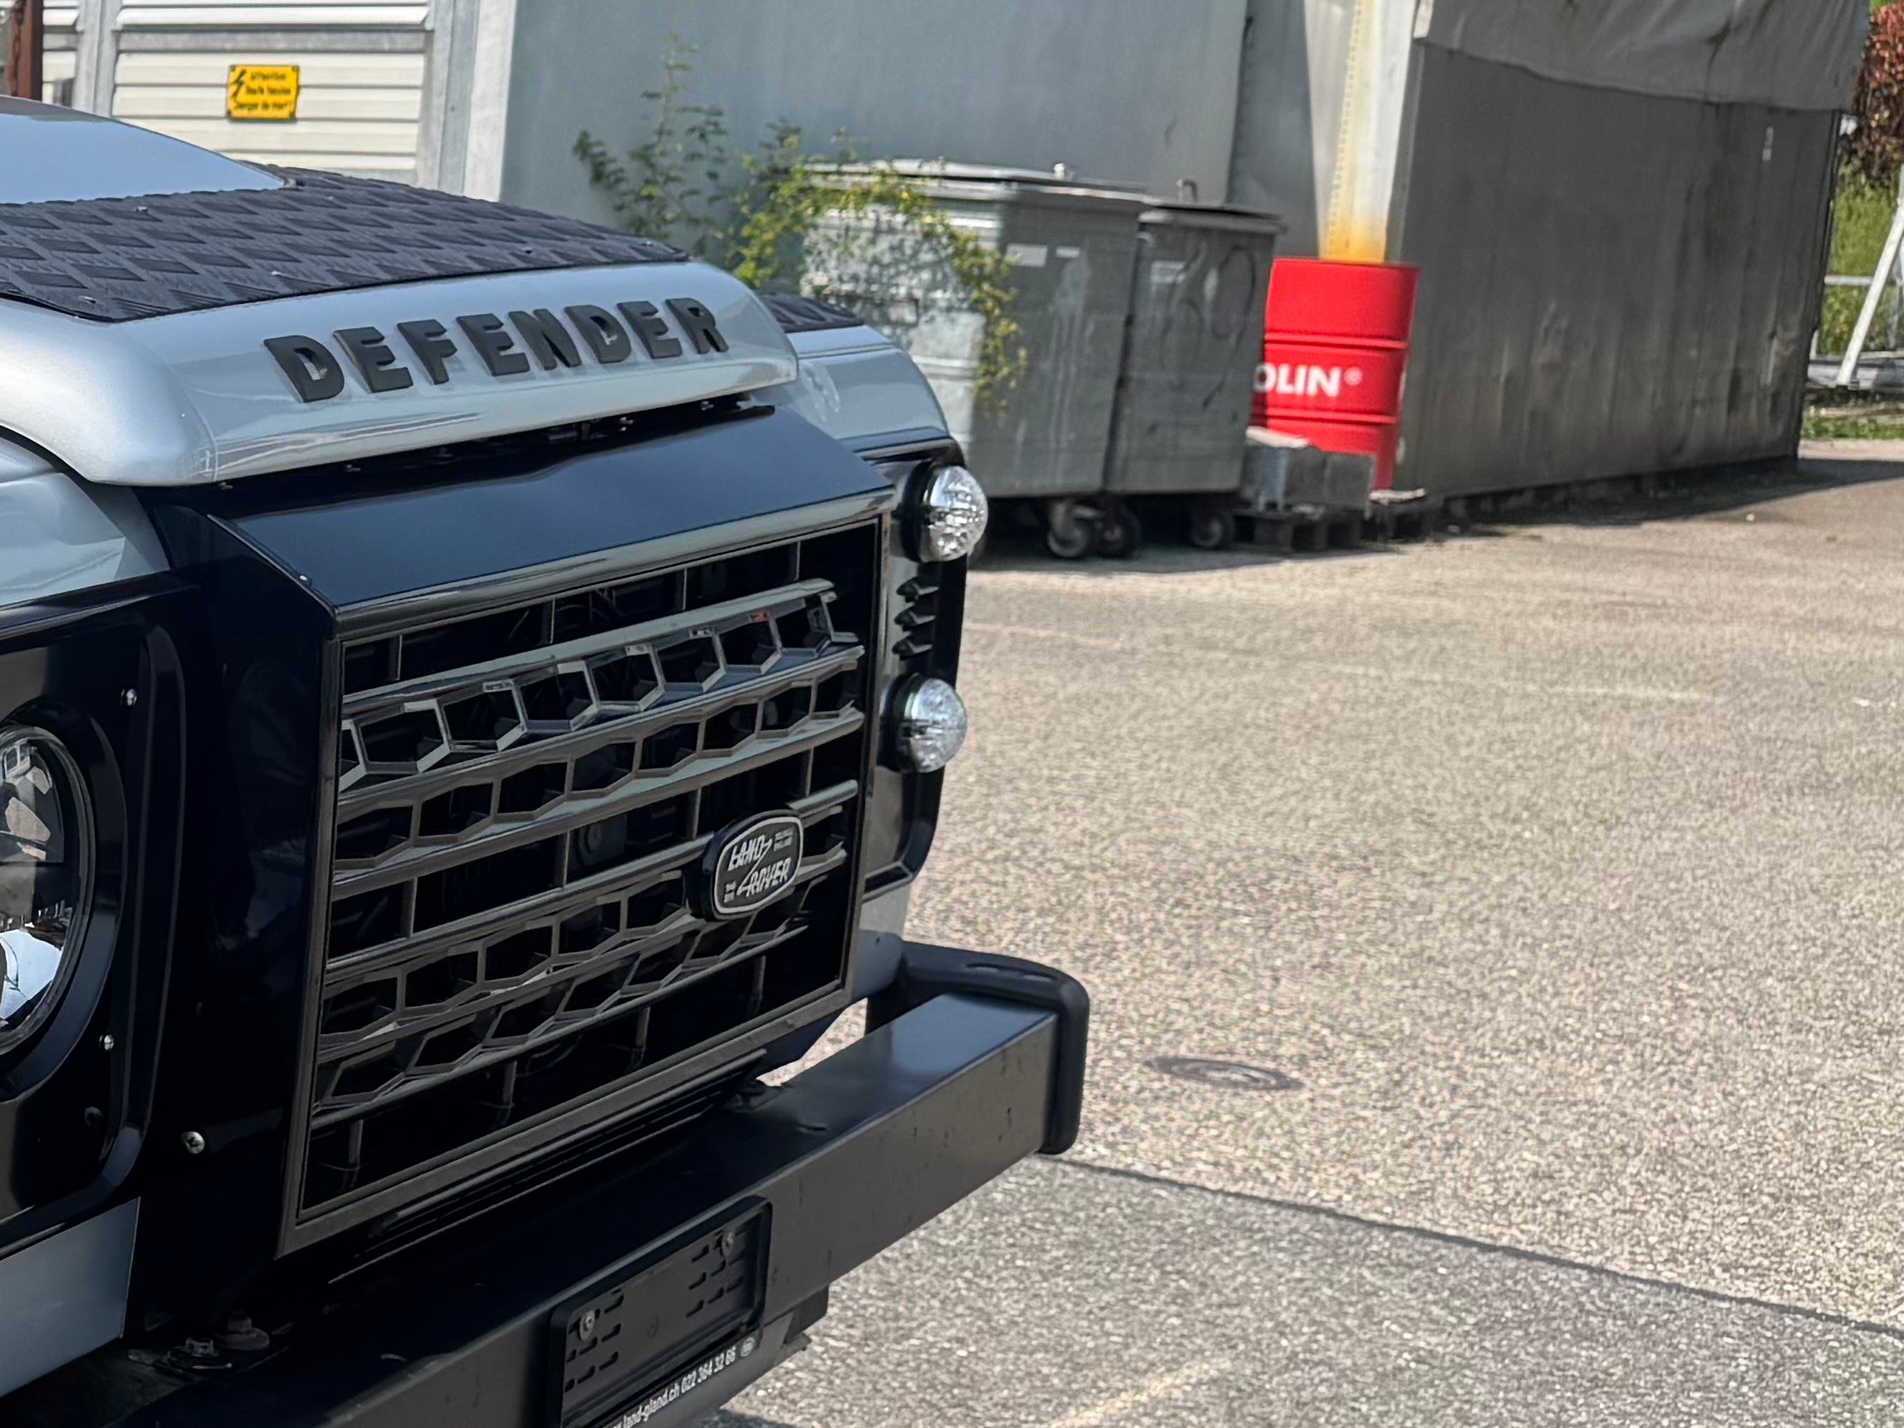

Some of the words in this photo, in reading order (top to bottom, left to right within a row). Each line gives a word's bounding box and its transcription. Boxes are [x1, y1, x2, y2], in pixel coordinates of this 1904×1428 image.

[264, 297, 729, 403] DEFENDER
[727, 834, 768, 871] LAND
[745, 856, 792, 897] ROVER
